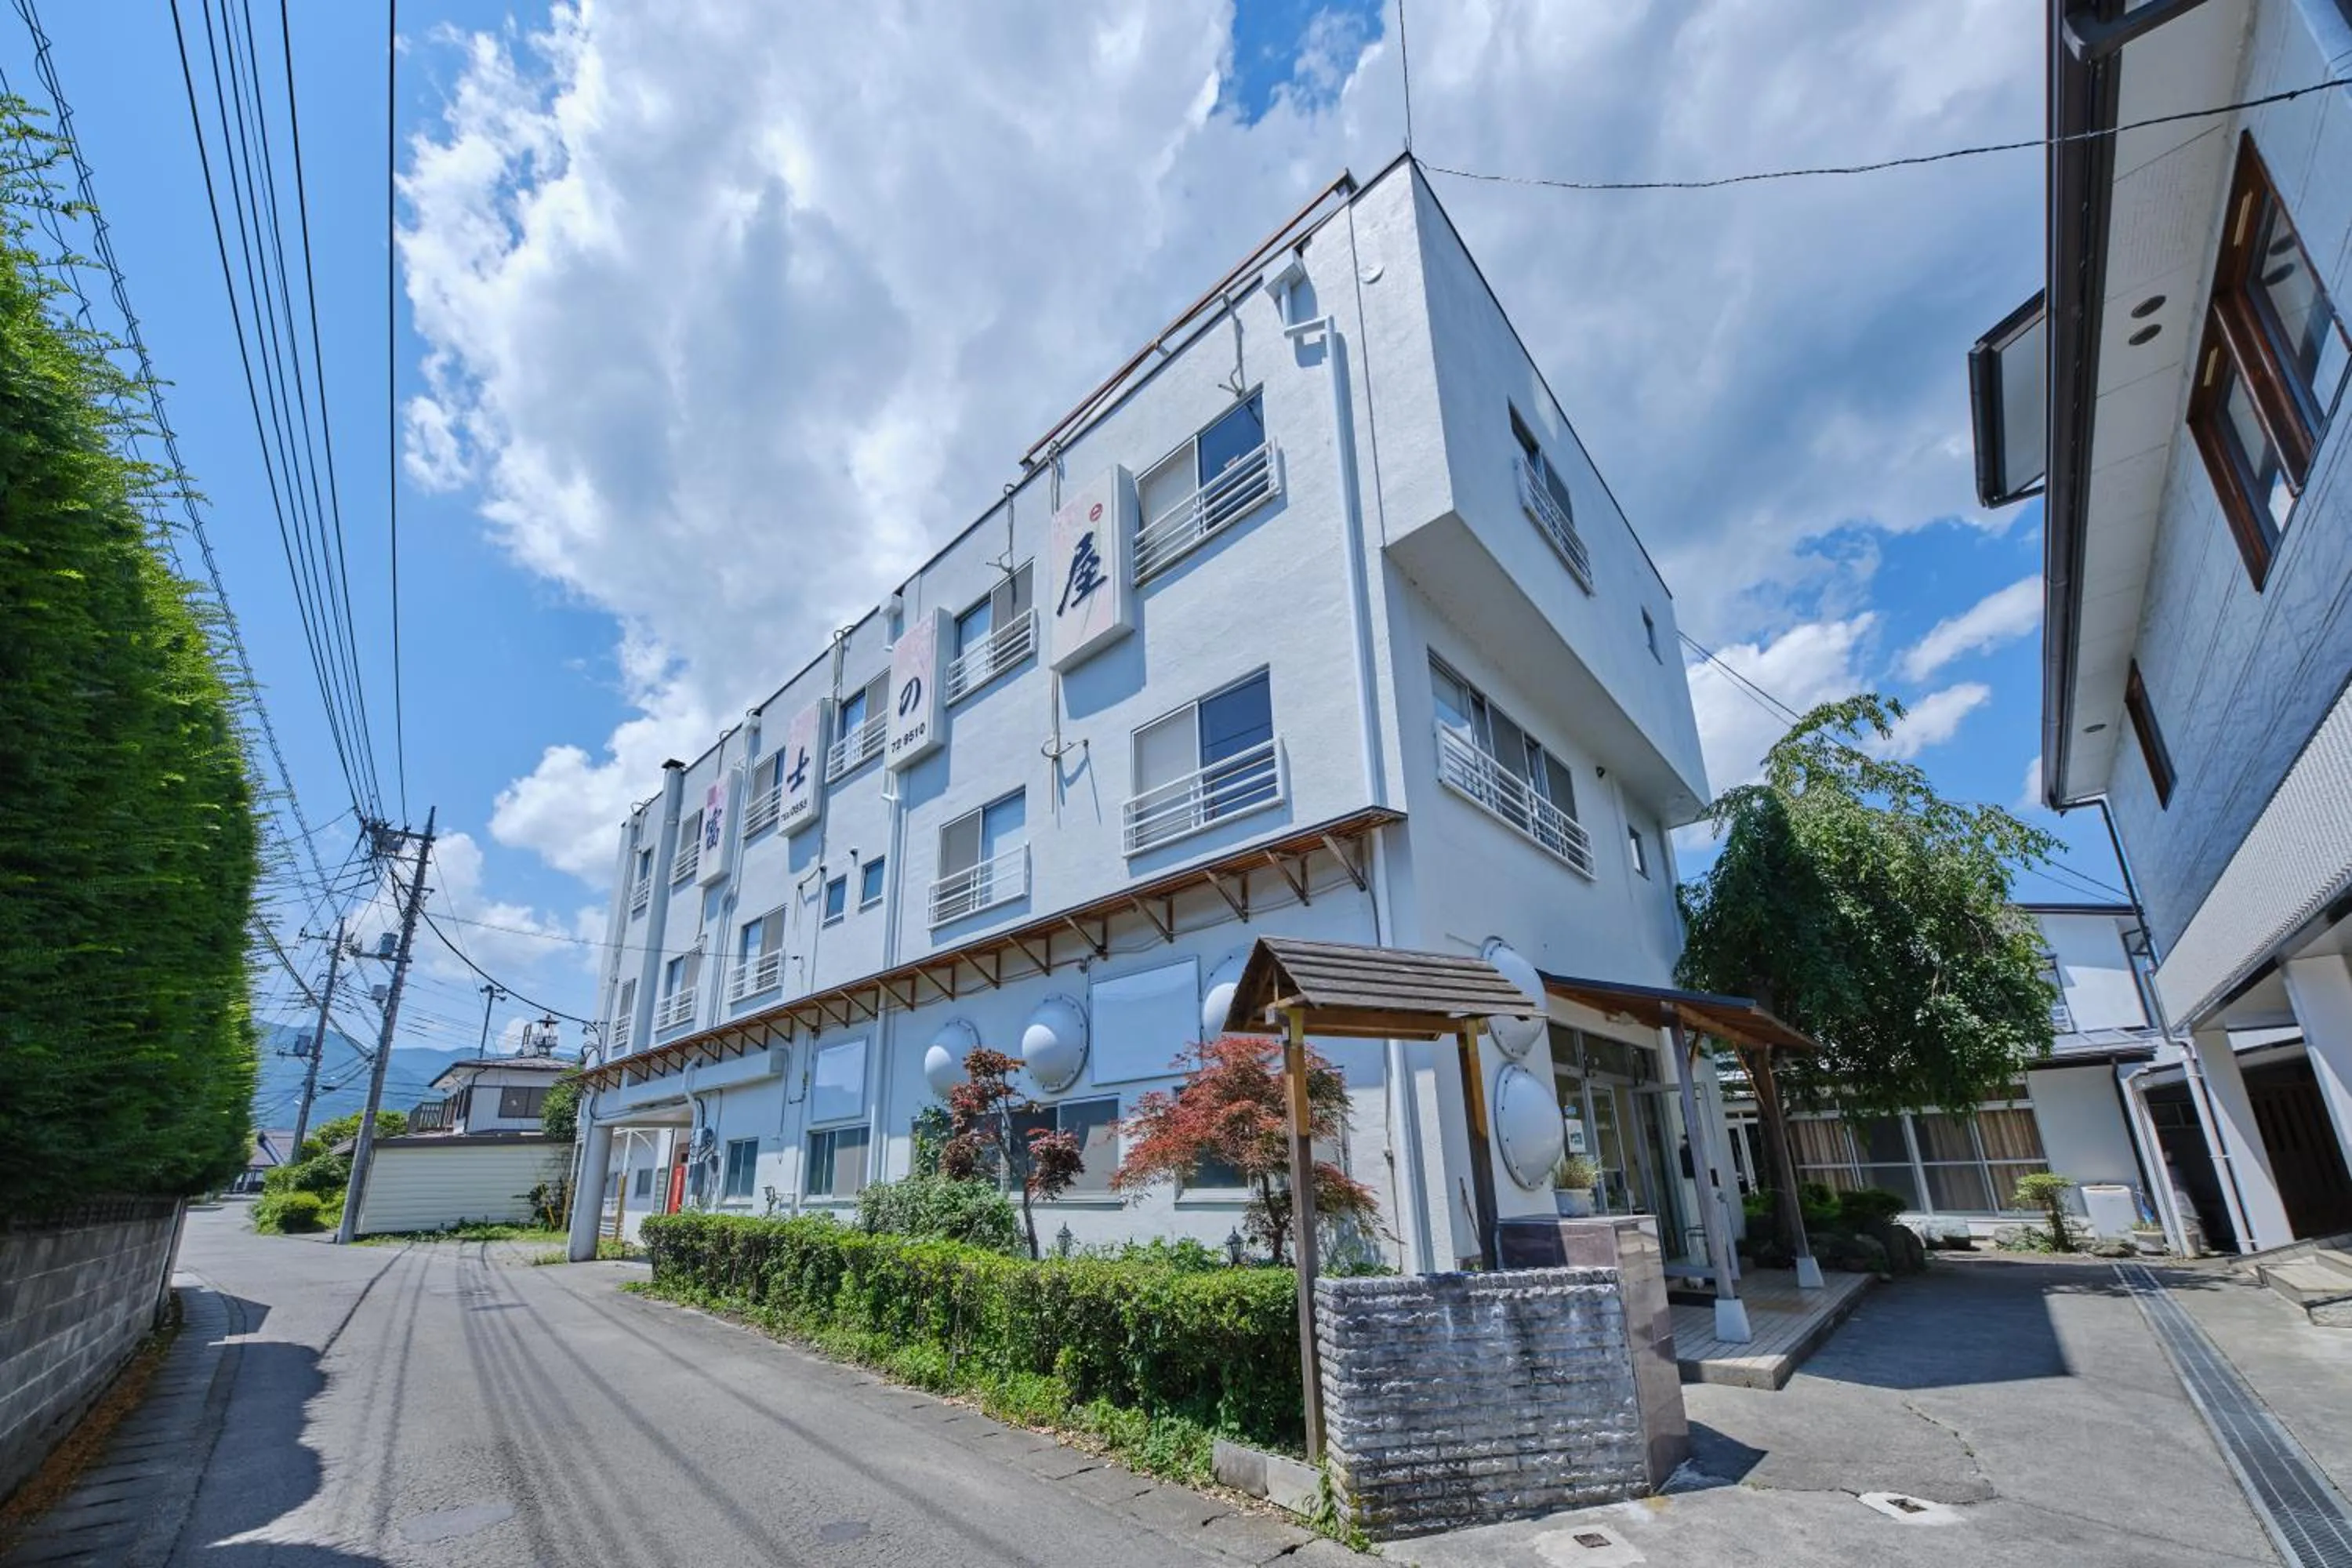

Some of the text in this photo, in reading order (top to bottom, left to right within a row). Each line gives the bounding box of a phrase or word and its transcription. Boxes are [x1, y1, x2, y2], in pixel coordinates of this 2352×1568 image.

[1056, 531, 1108, 617] 屋
[898, 677, 921, 717] の
[786, 746, 810, 793] 士
